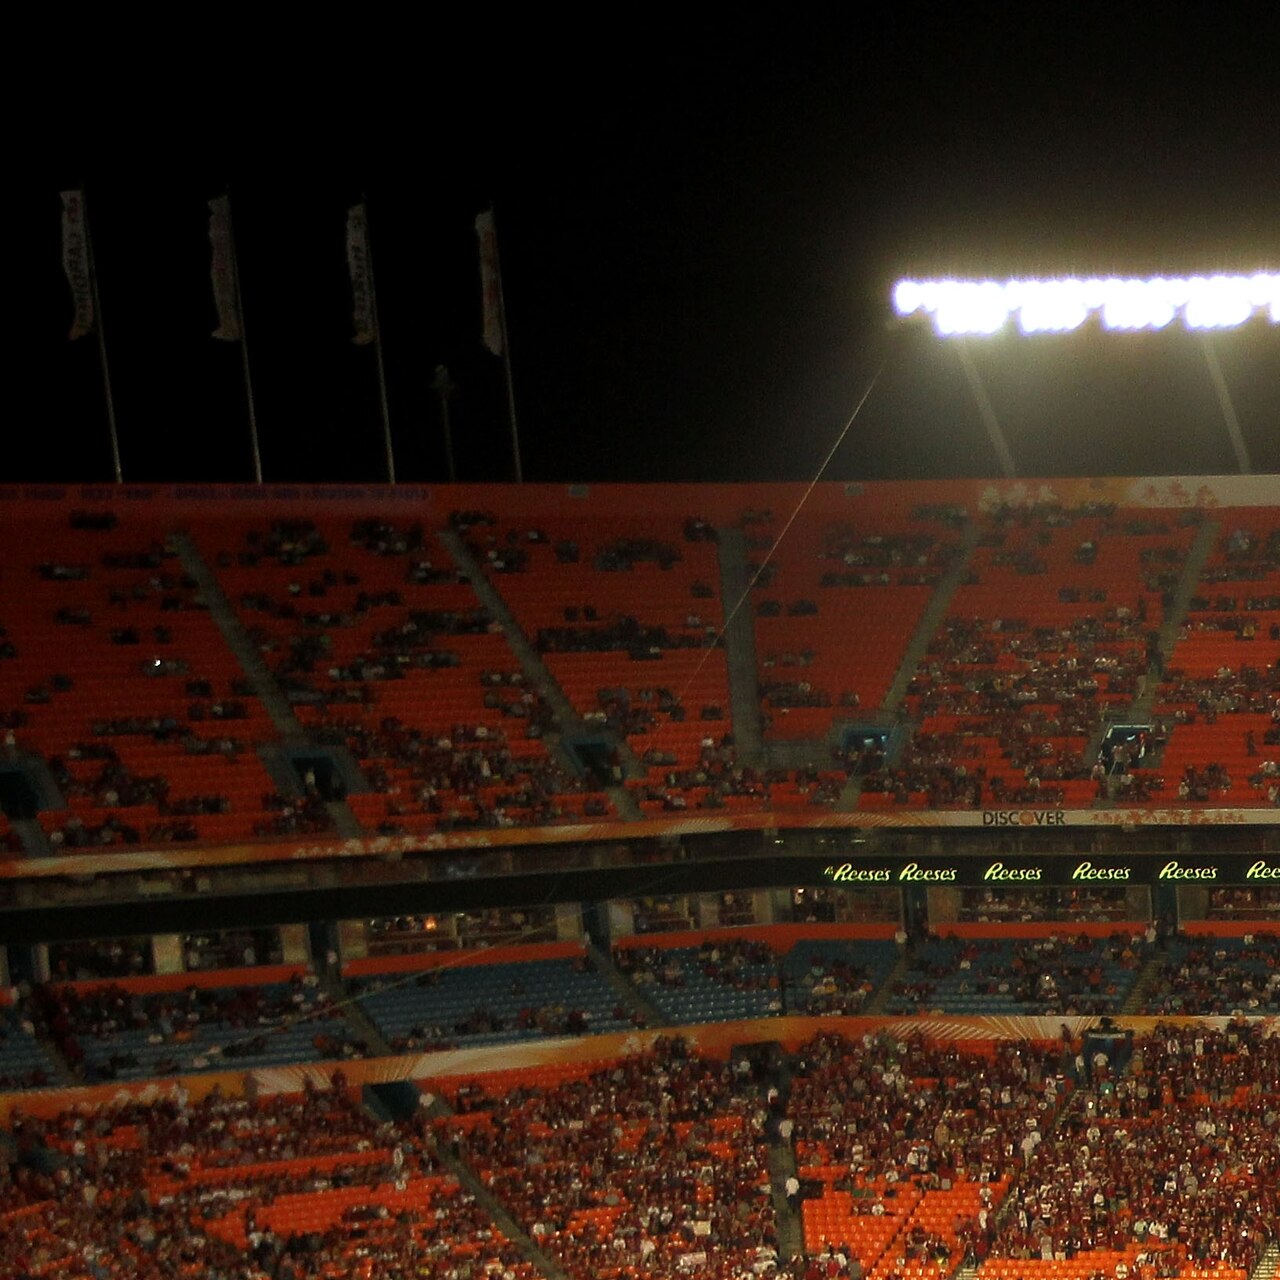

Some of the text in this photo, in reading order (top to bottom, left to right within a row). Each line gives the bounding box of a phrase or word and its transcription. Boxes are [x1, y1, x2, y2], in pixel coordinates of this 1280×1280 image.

[982, 812, 1065, 825] DISCOVER
[833, 863, 889, 881] Reese's
[899, 863, 957, 881] Reese's
[984, 862, 1043, 880] Reese's
[1072, 861, 1130, 880] Reese's
[1158, 861, 1218, 880] Reese's
